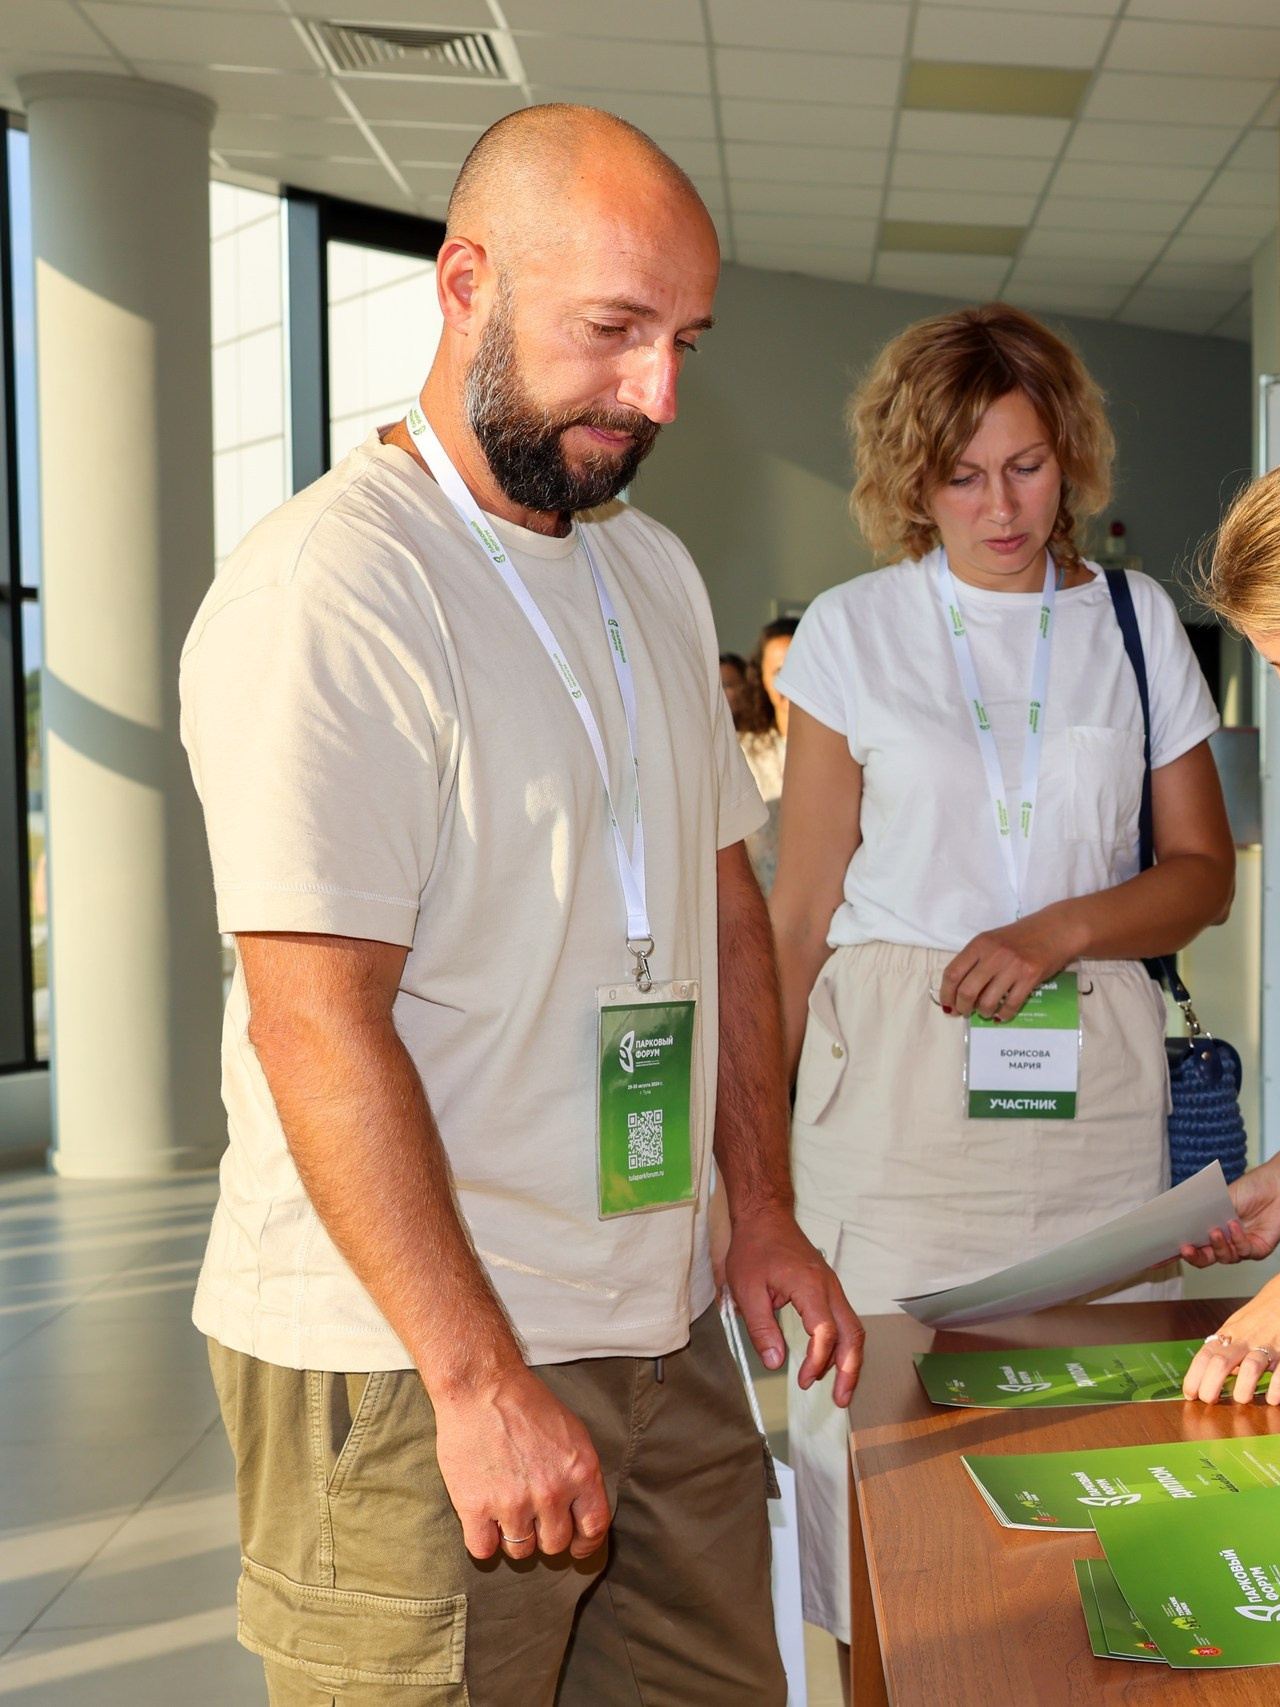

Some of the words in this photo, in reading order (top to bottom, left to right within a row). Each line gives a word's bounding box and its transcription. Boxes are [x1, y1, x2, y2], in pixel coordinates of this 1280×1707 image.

[470, 520, 495, 554] ПАРКОВЫЙ
[483, 528, 501, 552] ФОРУМ
[635, 1035, 673, 1048] ПАРКОВЫЙ
[635, 1048, 660, 1058] ФОРУМ
[1000, 1049, 1051, 1058] БОРИСОВА
[1009, 1062, 1042, 1070] МАРИЯ
[989, 1098, 1057, 1110] УЧАСТНИК
[628, 1169, 664, 1182] tulaparkforum.ru
[1071, 1472, 1103, 1497] ПАРКОВЫЙ
[1095, 1478, 1117, 1495] ФОРУМ
[1147, 1466, 1198, 1499] ДИПЛОМ
[1219, 1549, 1263, 1603] ПАРКОВЫЙ
[1249, 1566, 1280, 1601] ФОРУМ
